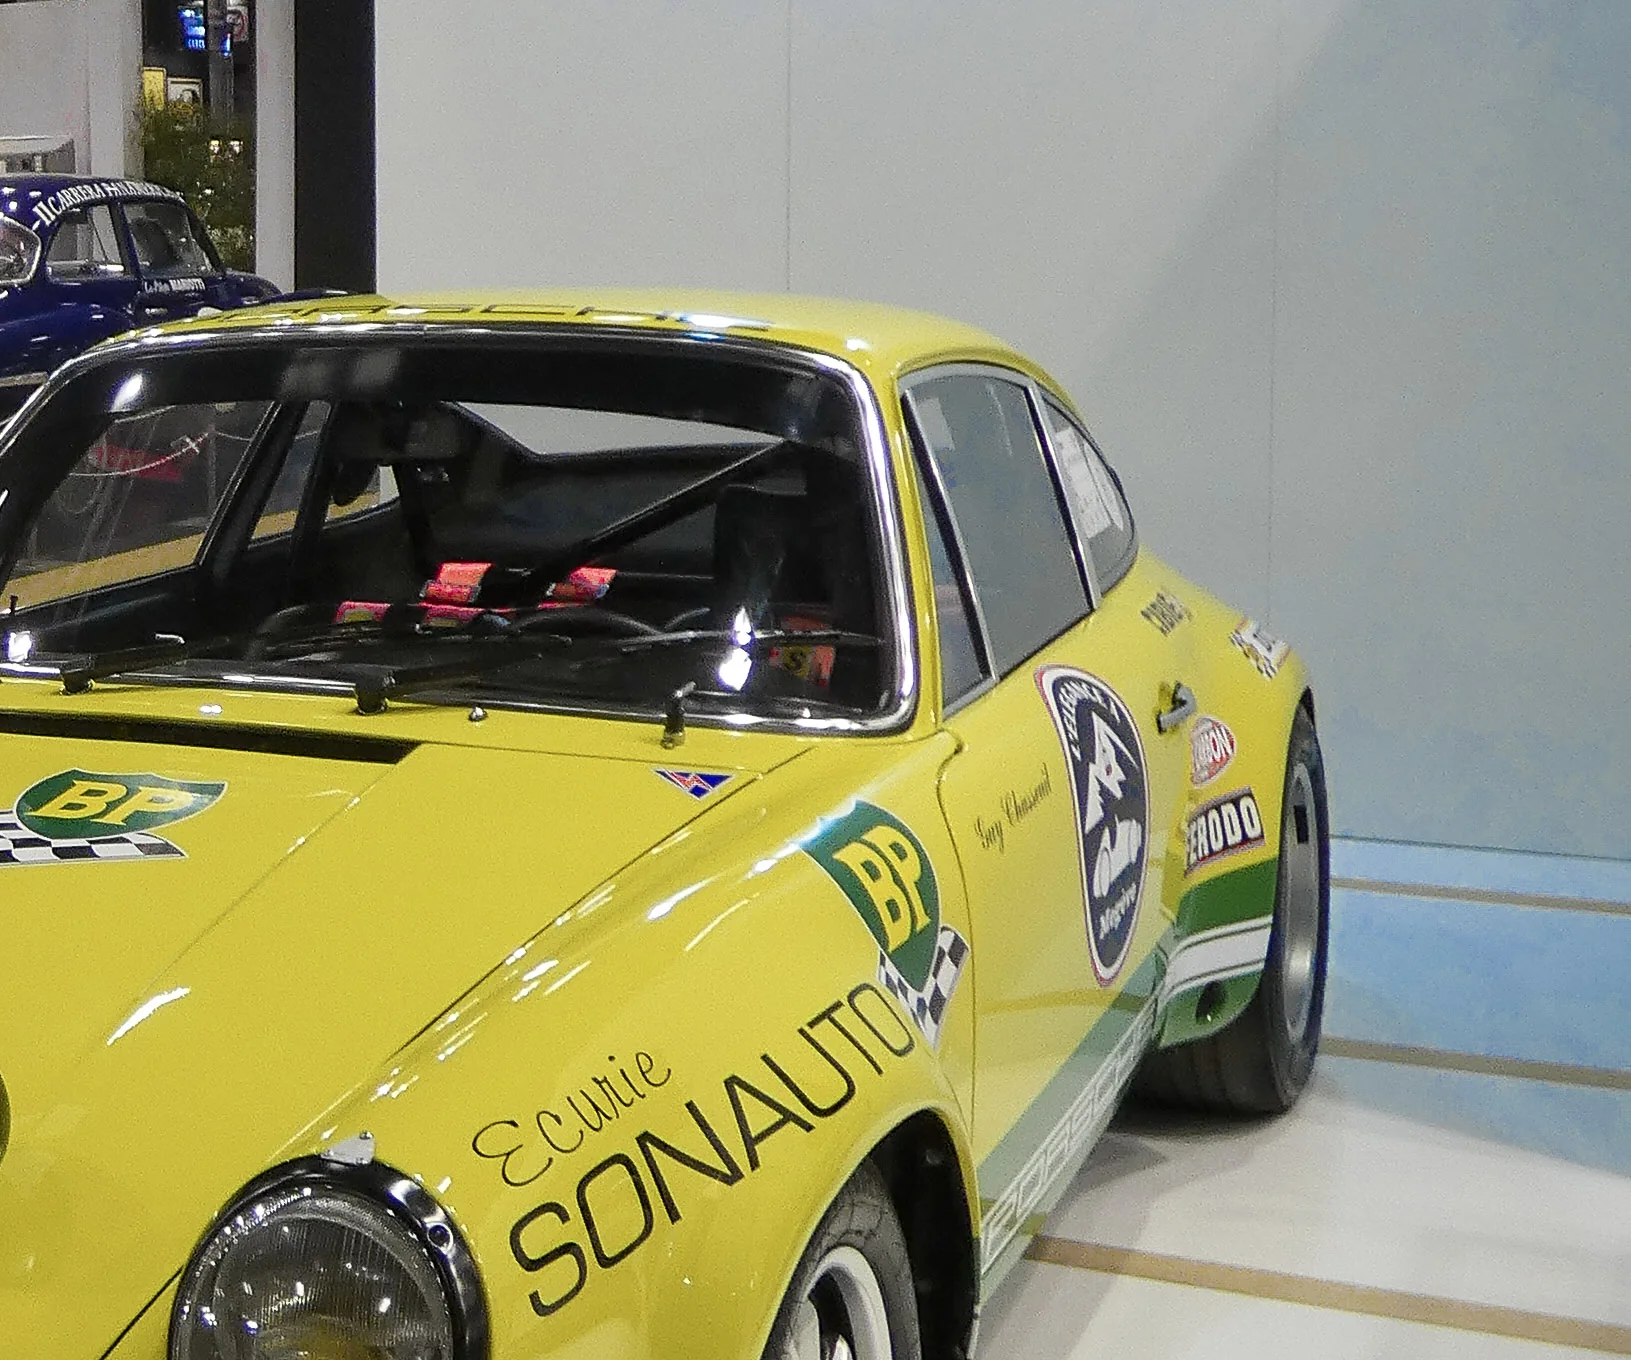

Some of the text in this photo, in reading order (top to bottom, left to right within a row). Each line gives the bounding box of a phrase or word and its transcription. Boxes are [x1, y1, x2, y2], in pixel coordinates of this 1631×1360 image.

[28, 779, 195, 827] BP
[832, 825, 931, 953] BP
[471, 1051, 672, 1188] Ecurie
[508, 982, 916, 1318] SONAUTO
